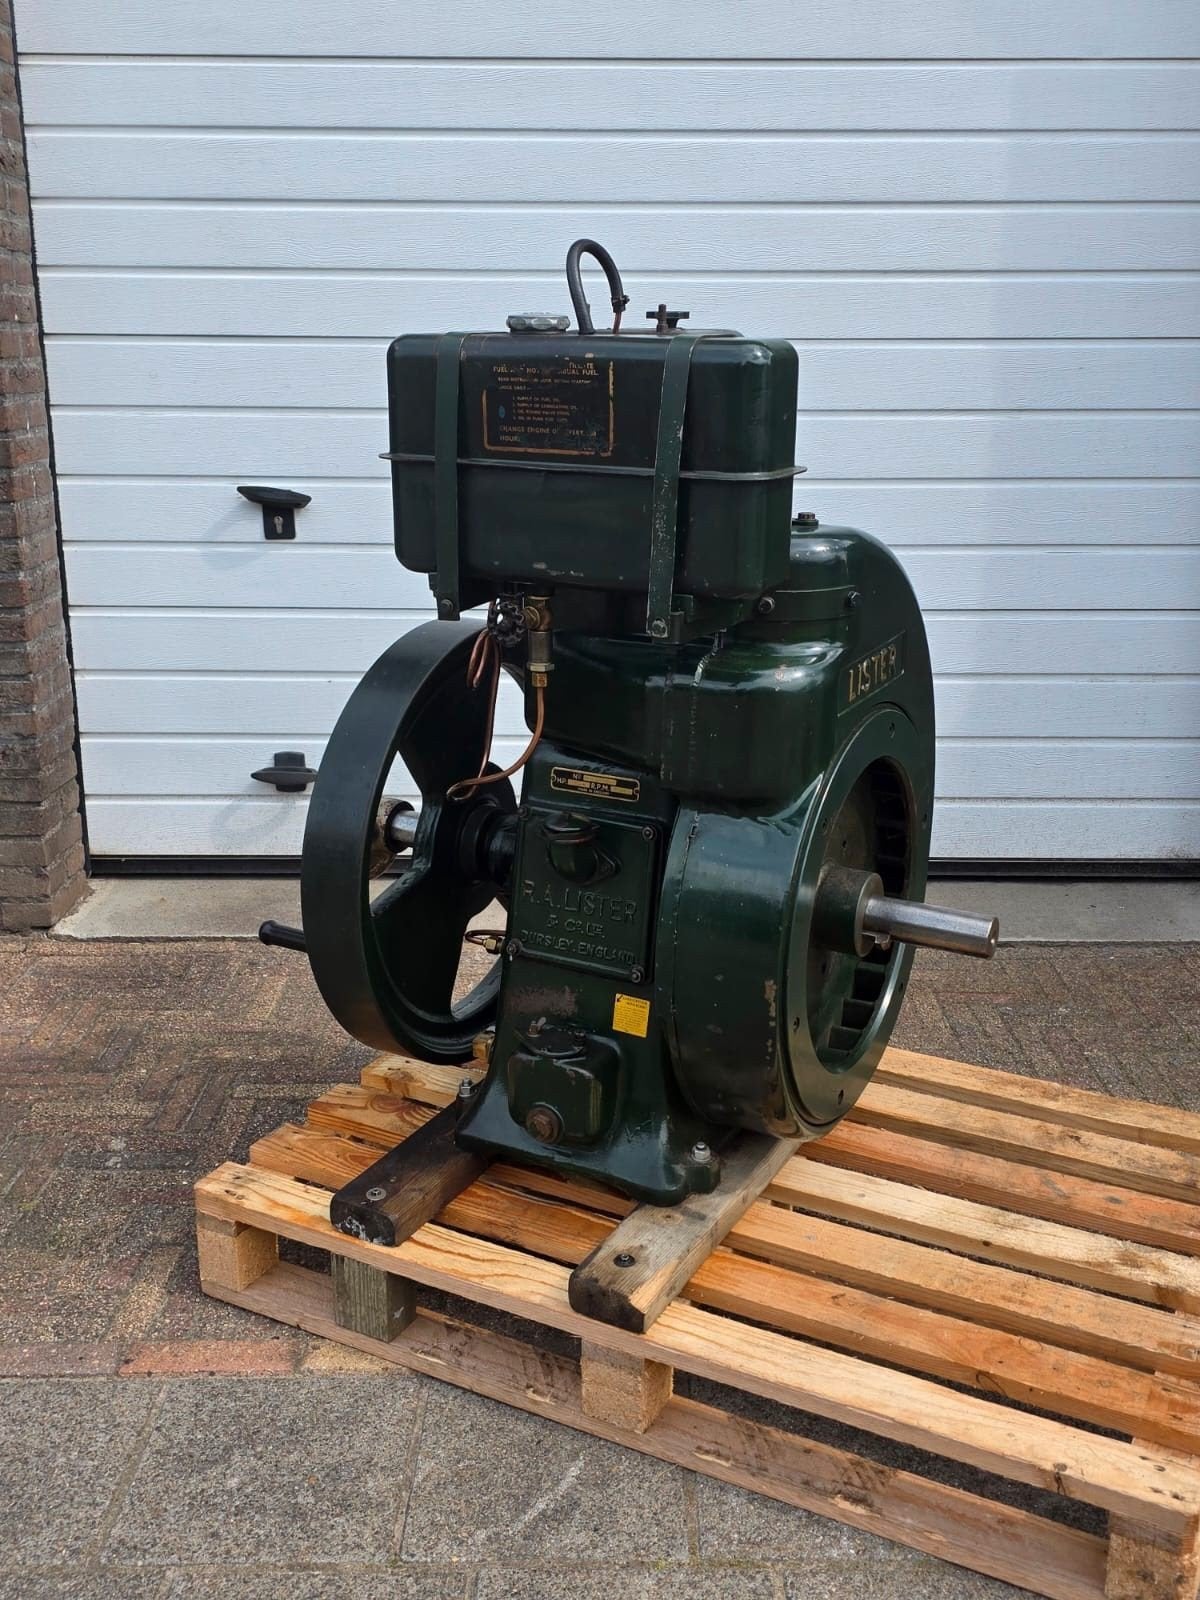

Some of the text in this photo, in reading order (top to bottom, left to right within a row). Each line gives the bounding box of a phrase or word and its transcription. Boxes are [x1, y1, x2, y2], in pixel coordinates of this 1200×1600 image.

[492, 366, 508, 374] FUEL
[848, 643, 897, 703] LISTER
[564, 887, 638, 923] LISTER
